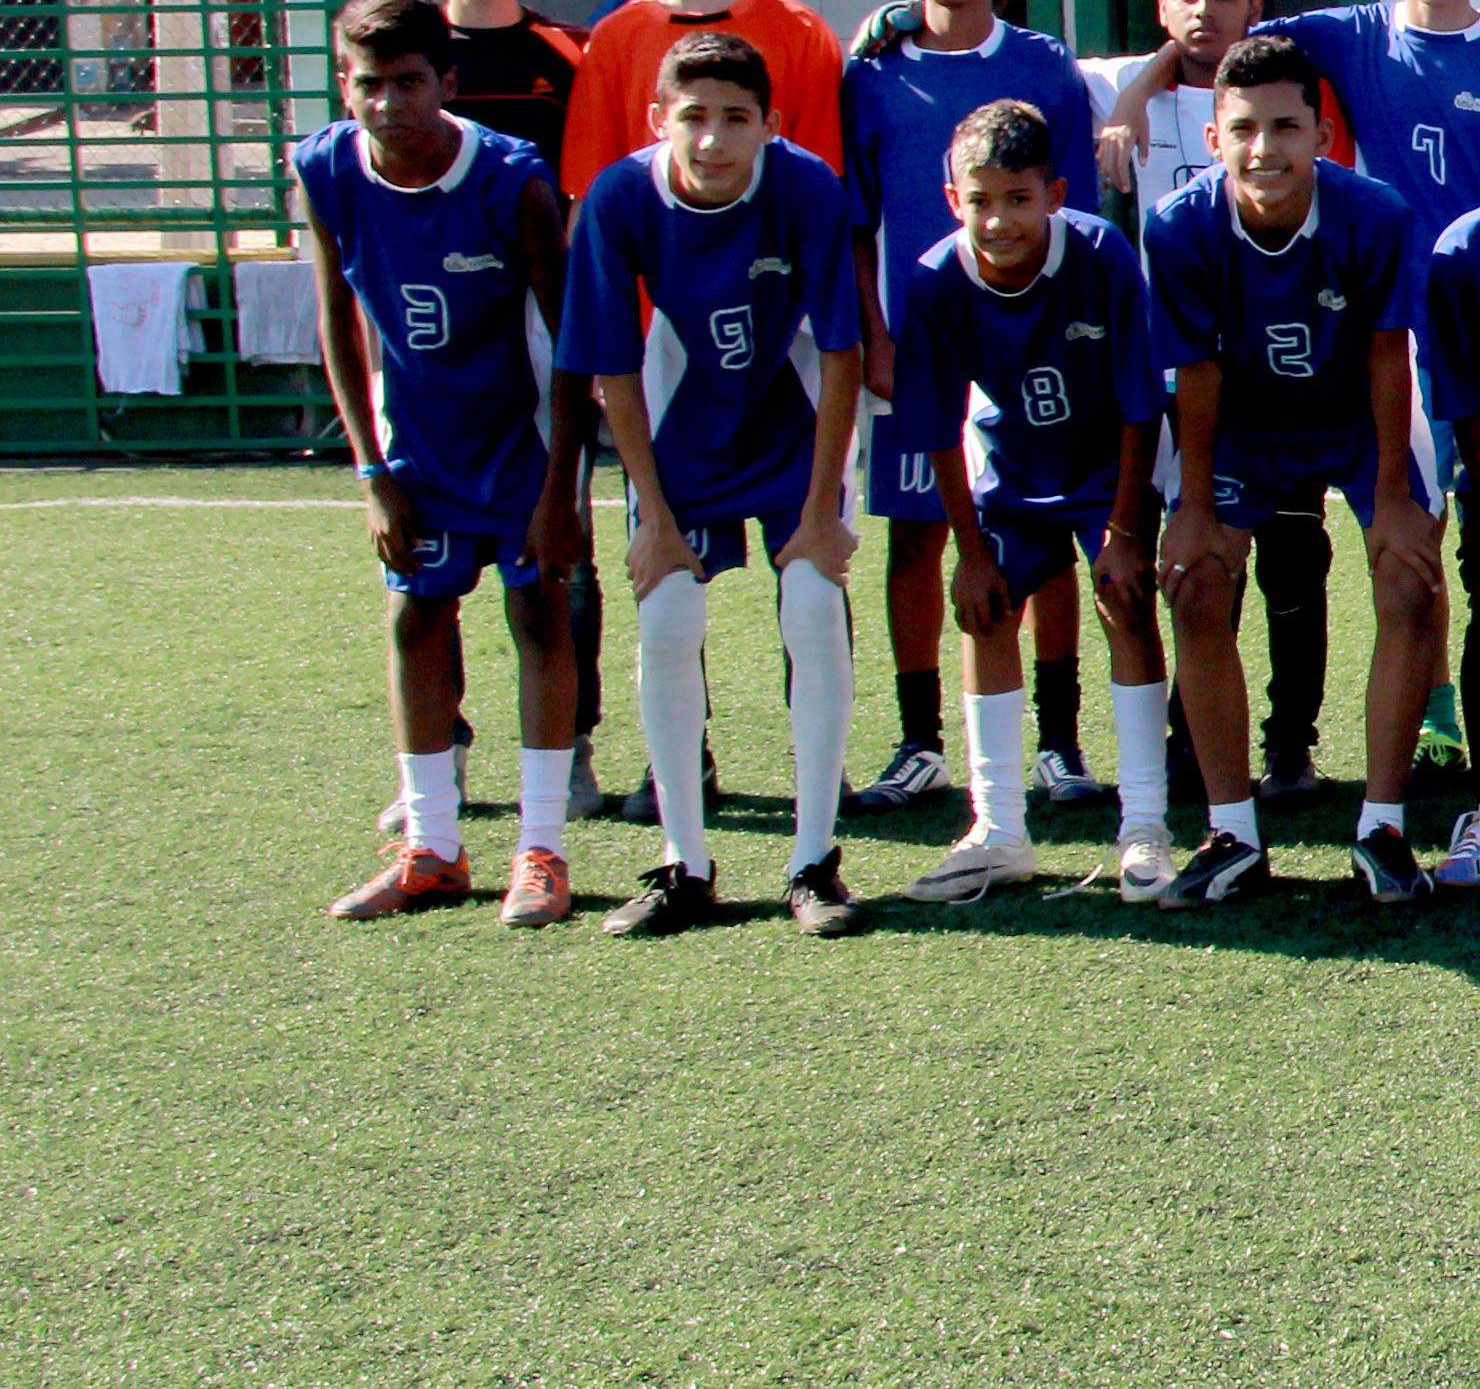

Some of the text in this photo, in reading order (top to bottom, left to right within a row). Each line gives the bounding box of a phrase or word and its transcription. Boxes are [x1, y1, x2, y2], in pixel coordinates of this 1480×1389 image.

[1412, 123, 1446, 184] 7
[400, 283, 450, 350] 3
[709, 304, 754, 370] 9
[1266, 323, 1315, 378] 2
[1021, 366, 1071, 426] 8
